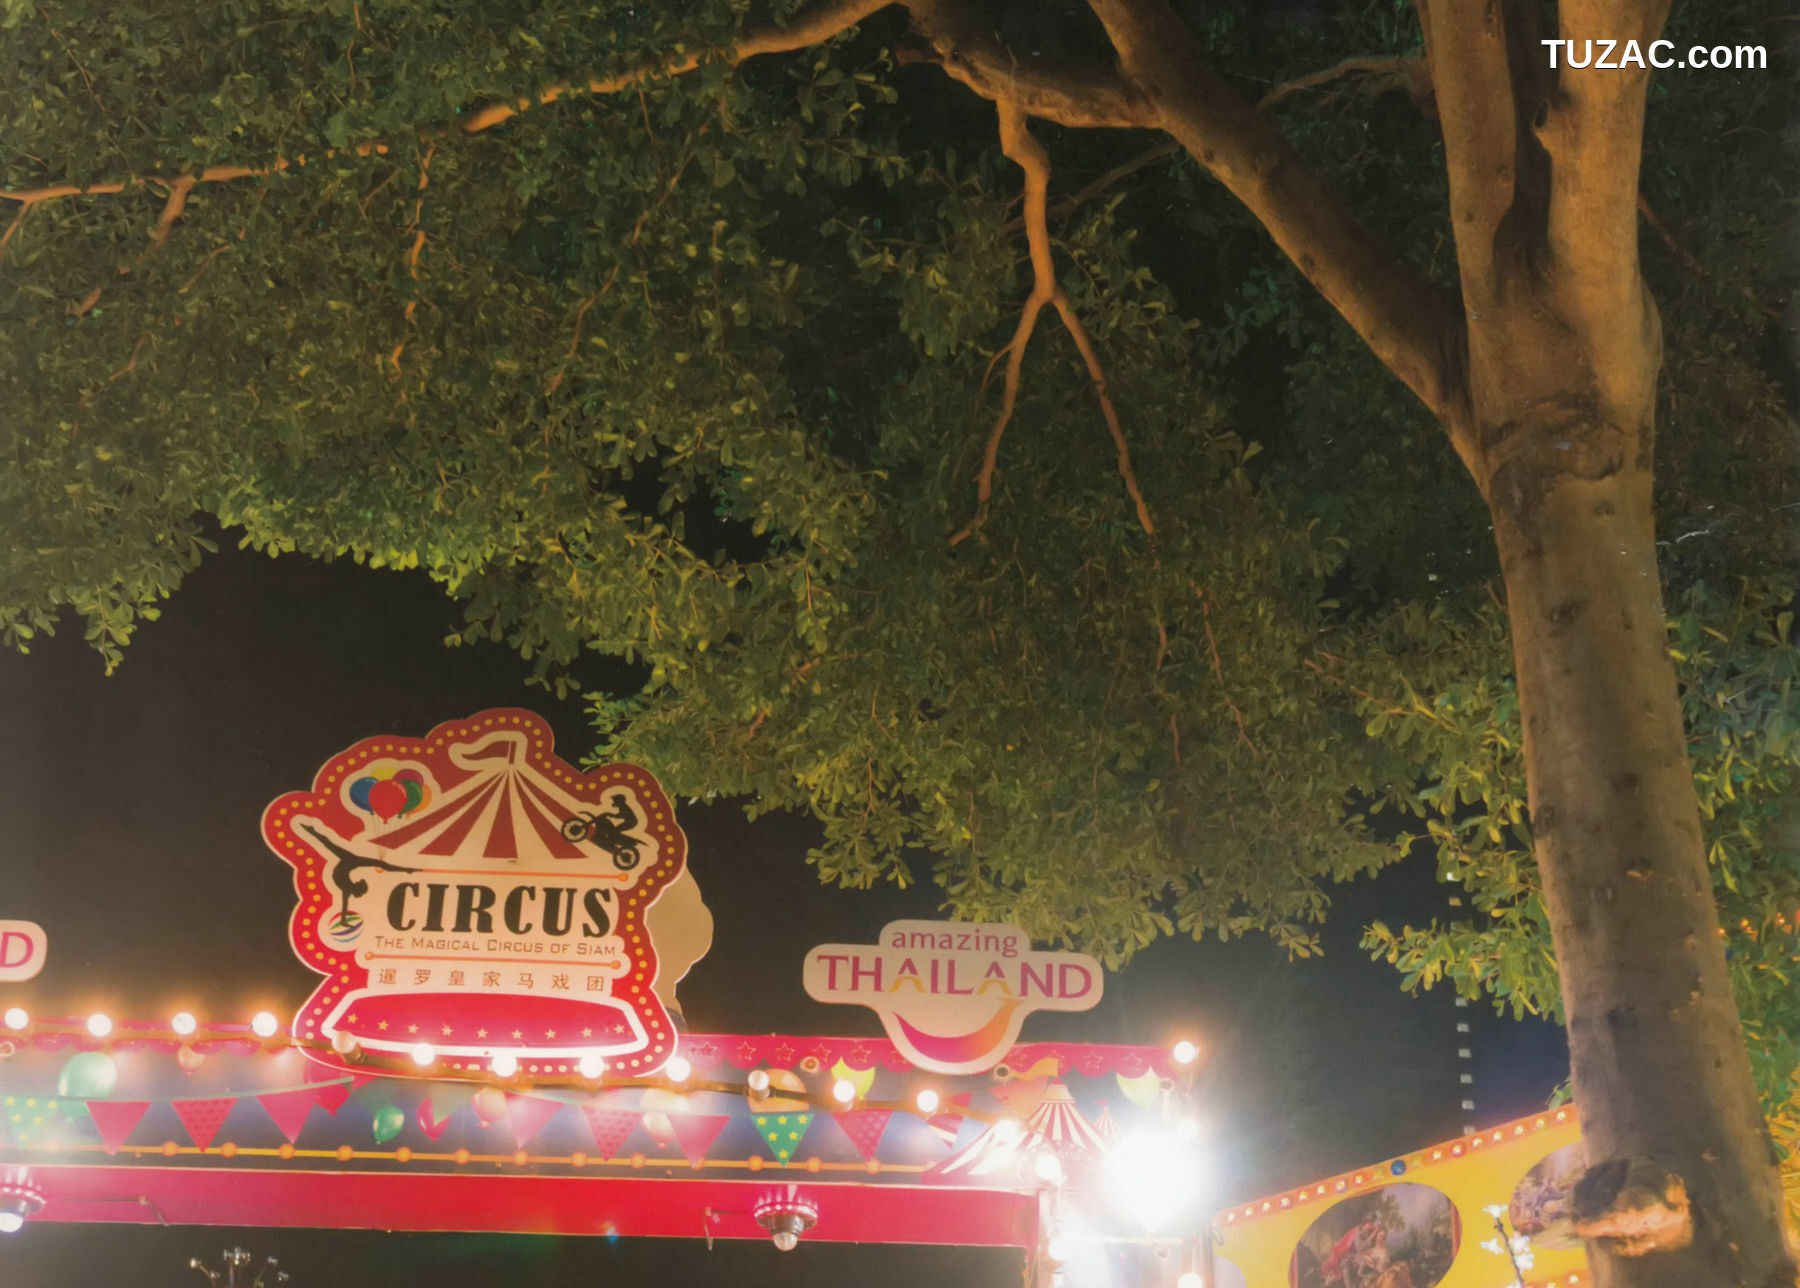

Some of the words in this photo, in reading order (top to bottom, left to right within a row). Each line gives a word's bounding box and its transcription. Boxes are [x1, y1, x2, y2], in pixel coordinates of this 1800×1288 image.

[386, 881, 612, 939] CIRCUS
[374, 935, 404, 949] THE
[411, 936, 480, 951] MAGICAL
[486, 938, 543, 954] CIRCUS
[576, 942, 615, 956] SIAM
[891, 928, 1018, 958] amazing
[378, 968, 605, 992] 暹罗皇家马戏团
[816, 954, 1093, 999] THAILAND
